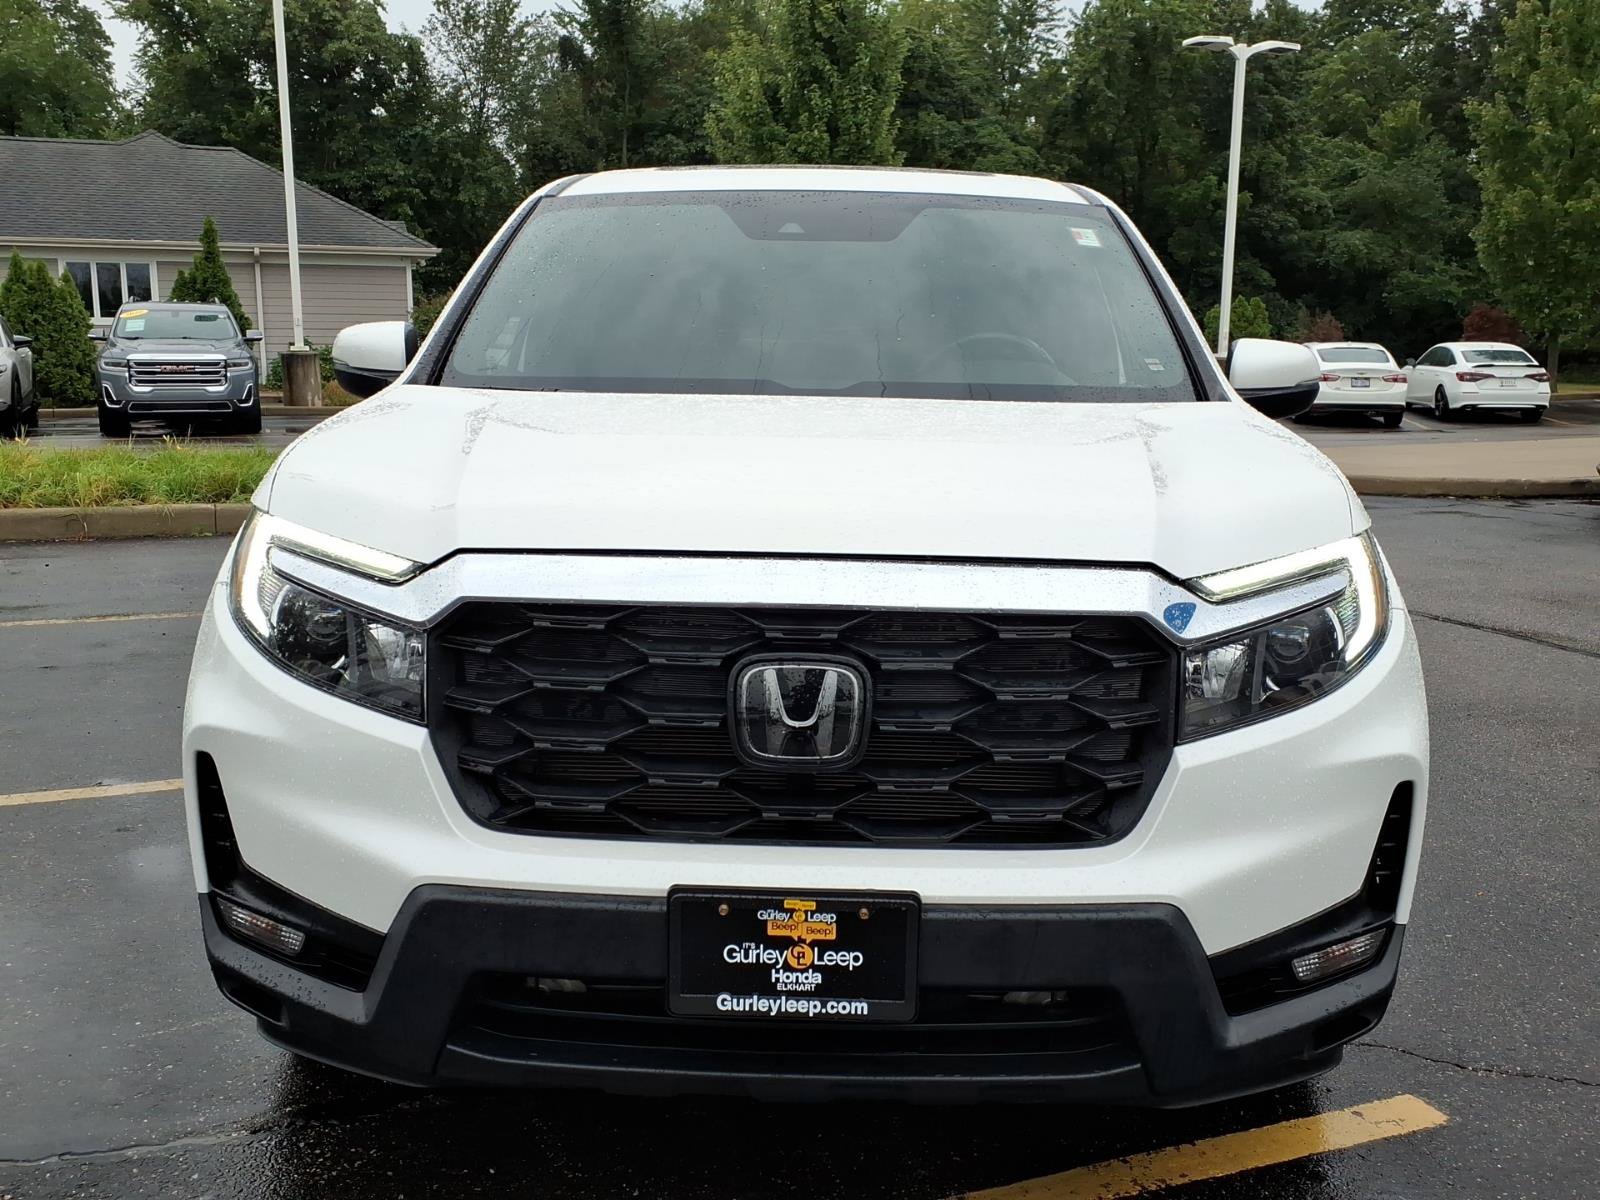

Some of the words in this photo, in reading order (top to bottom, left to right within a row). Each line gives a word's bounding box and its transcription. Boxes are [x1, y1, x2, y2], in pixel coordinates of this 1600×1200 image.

[807, 911, 837, 925] Leep
[771, 921, 800, 932] Beep!
[806, 926, 834, 937] Beep!
[723, 944, 788, 969] Gurley
[814, 946, 864, 971] Leep
[771, 969, 822, 984] Honda
[776, 983, 816, 992] ELKHART
[716, 994, 868, 1017] Gurleyleep.com
